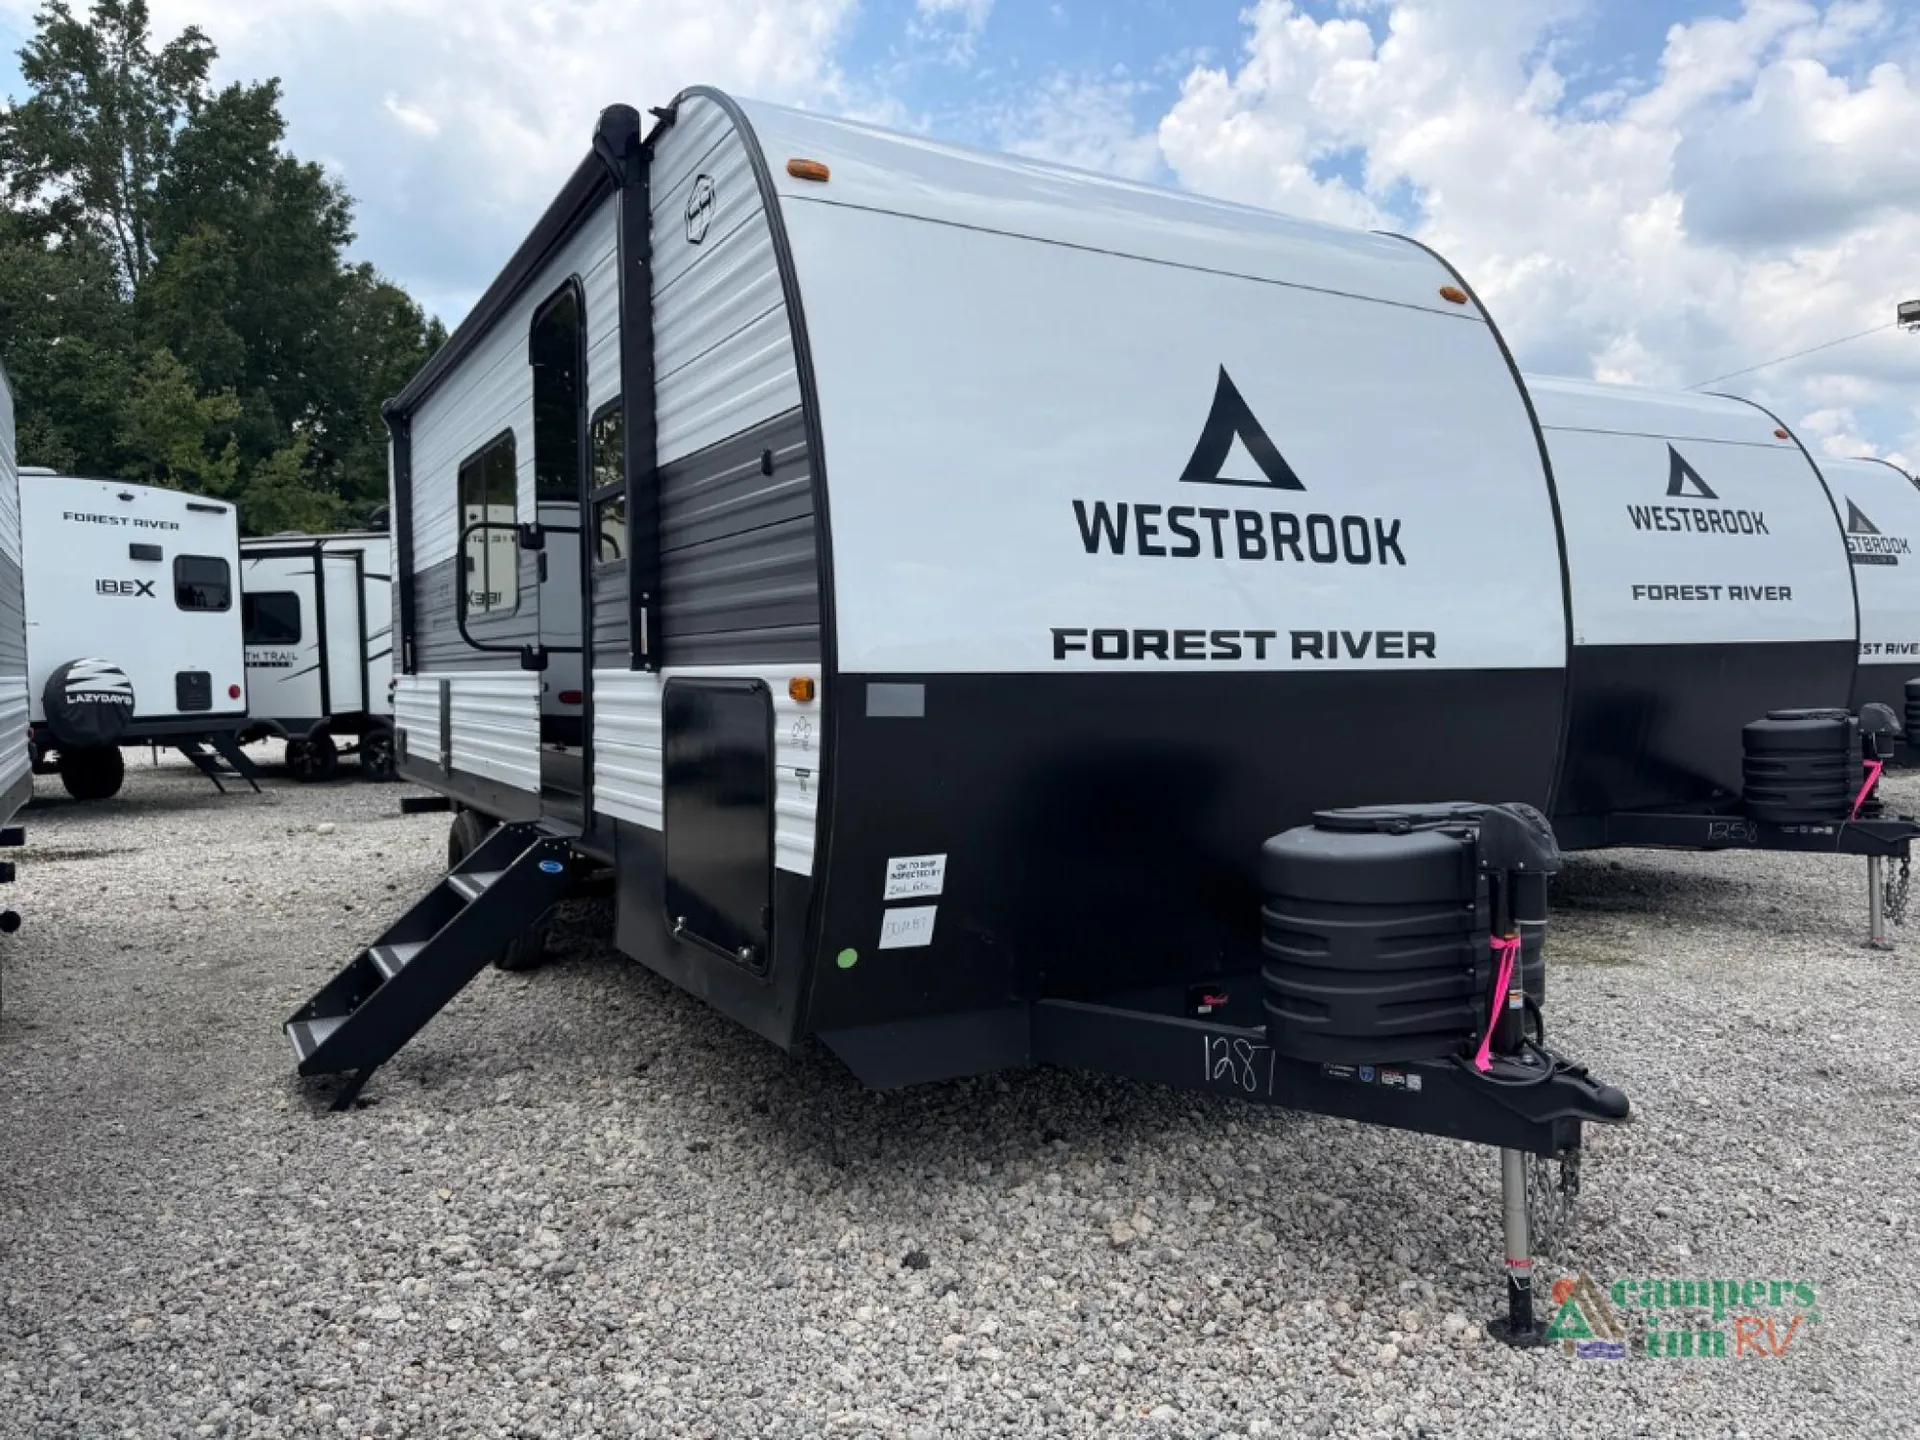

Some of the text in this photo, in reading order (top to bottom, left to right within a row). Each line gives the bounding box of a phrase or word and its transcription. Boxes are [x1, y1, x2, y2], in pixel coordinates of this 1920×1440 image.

[62, 511, 179, 530] FOREST RIVER
[1627, 504, 1771, 535] WESTBROOK
[1072, 499, 1406, 565] WESTBROOK
[1846, 535, 1912, 554] STBROOK
[95, 579, 156, 598] IBEX
[1631, 584, 1793, 601] FOREST RIVER
[1049, 628, 1437, 661] FOREST RIVER
[1885, 642, 1920, 655] RIVE
[263, 650, 299, 661] TRAIL
[66, 693, 132, 706] LAZYDAYS
[1204, 1035, 1275, 1096] 1287
